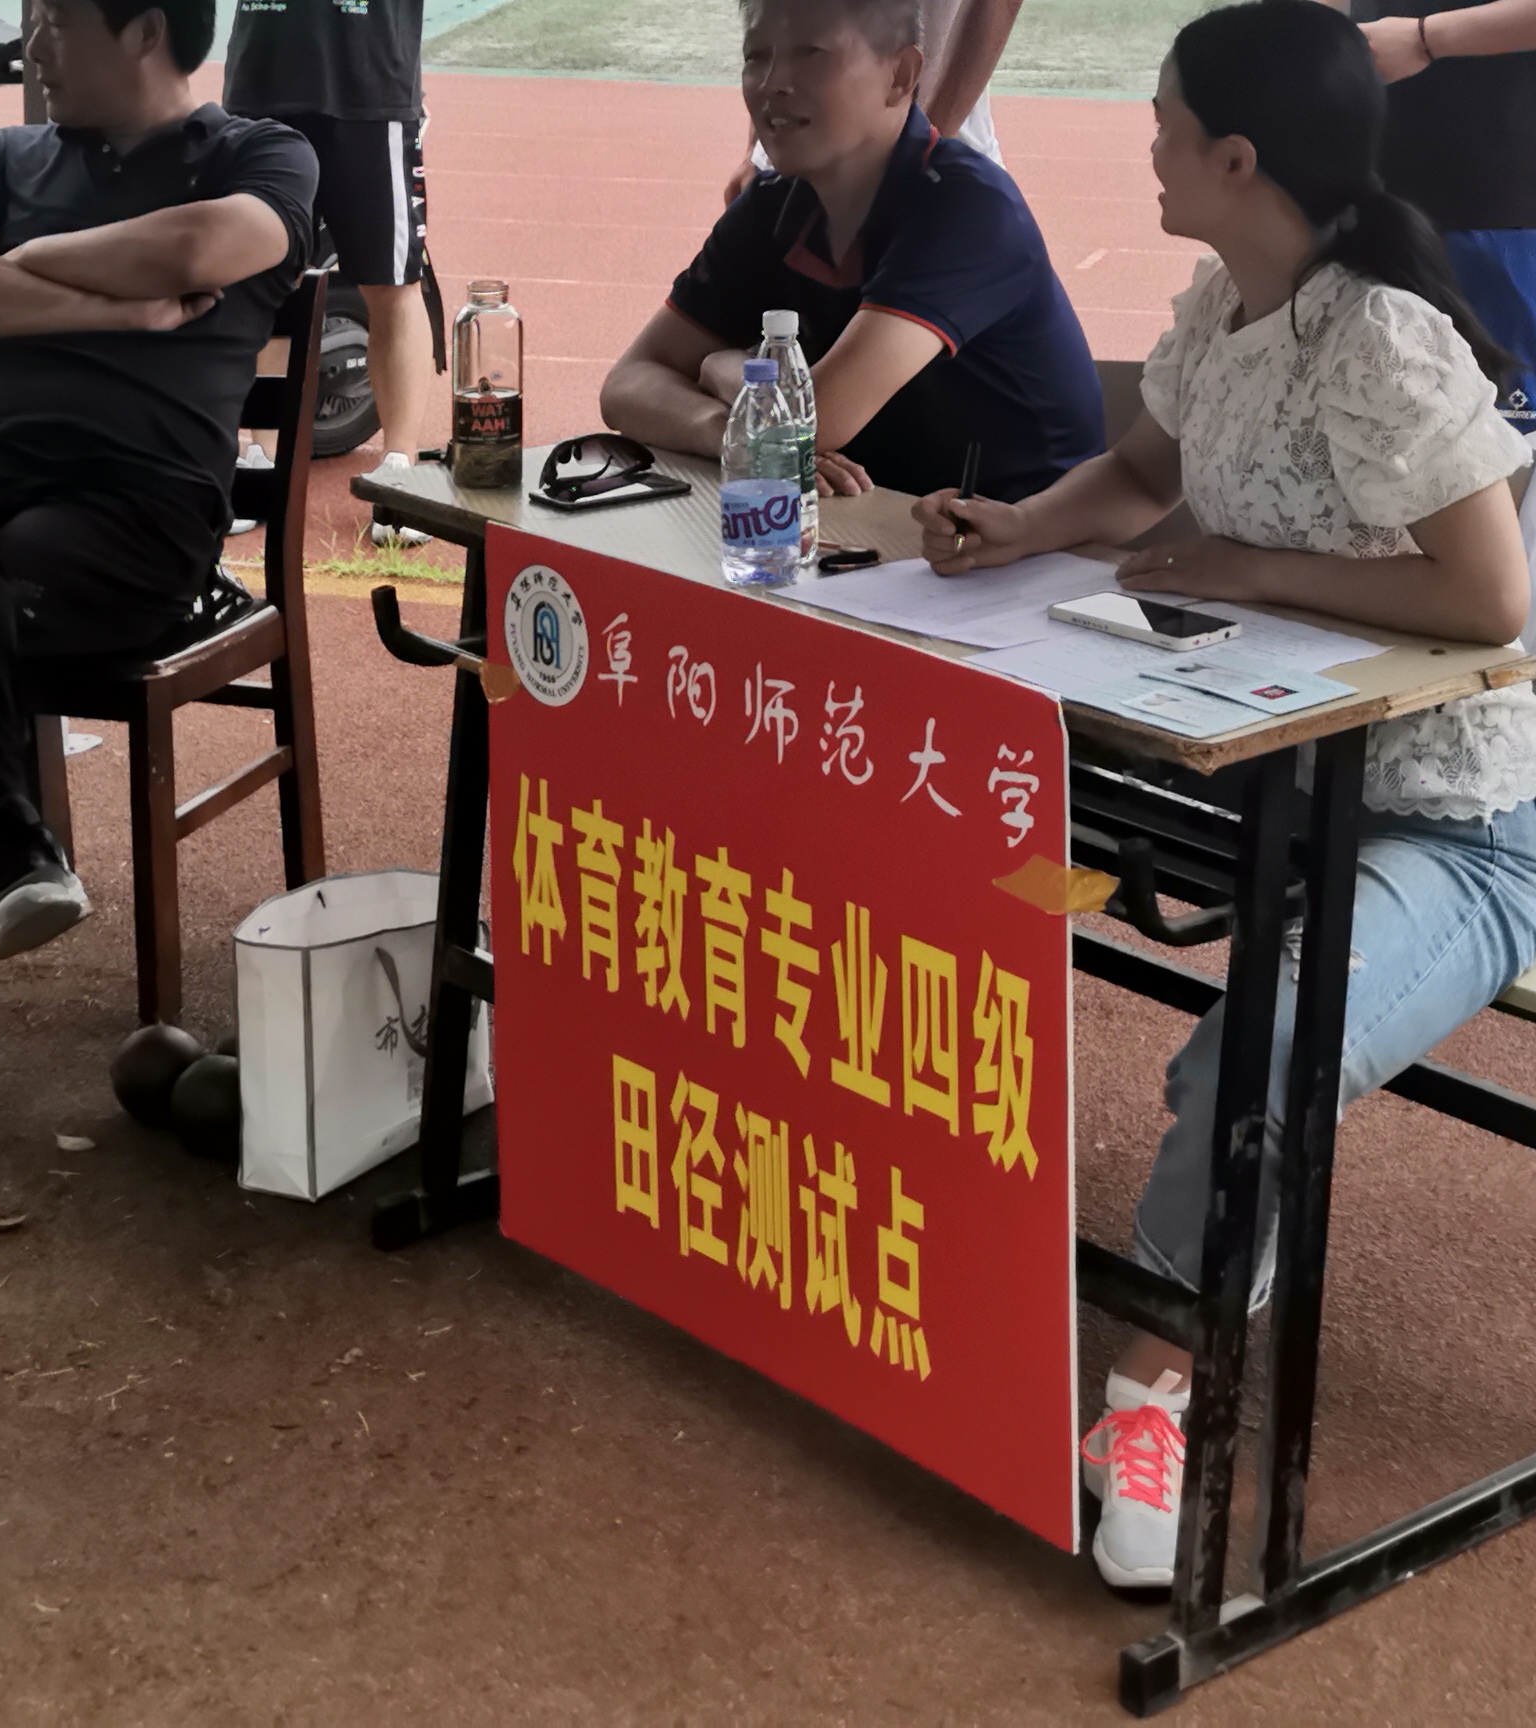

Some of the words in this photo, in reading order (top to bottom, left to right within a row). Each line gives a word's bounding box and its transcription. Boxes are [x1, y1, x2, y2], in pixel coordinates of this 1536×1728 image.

[597, 613, 1040, 848] 阜阳师范大学
[514, 772, 1039, 1181] 体育教育专业四级
[612, 1054, 932, 1382] 田径测试点
